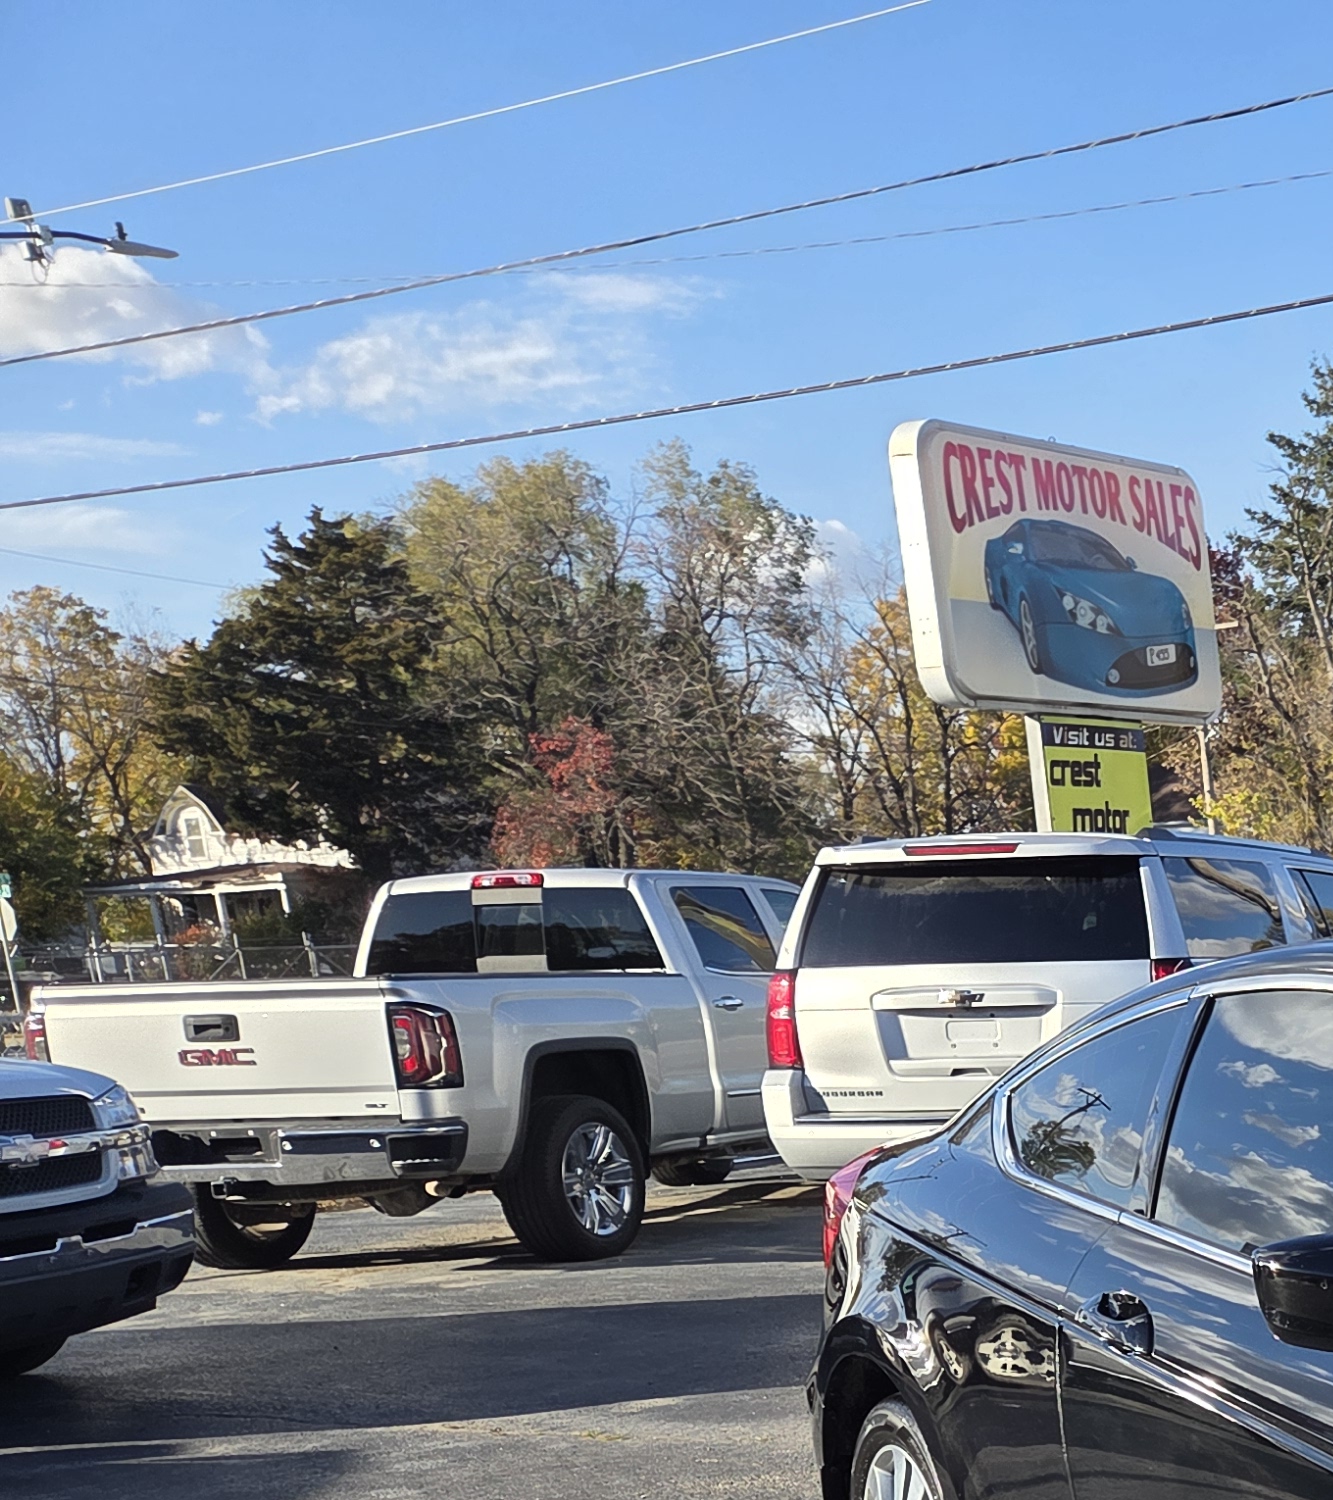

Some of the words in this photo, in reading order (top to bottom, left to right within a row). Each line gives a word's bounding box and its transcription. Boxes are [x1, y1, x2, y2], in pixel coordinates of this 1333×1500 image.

[942, 440, 1027, 534] CREST
[1031, 457, 1127, 526] MOTOR
[1128, 475, 1202, 572] SALES
[1053, 726, 1090, 746] Visit
[1094, 732, 1115, 747] us
[1119, 731, 1137, 749] at:
[1049, 753, 1101, 788] crest
[1072, 800, 1130, 834] motor
[177, 1048, 257, 1067] GMC
